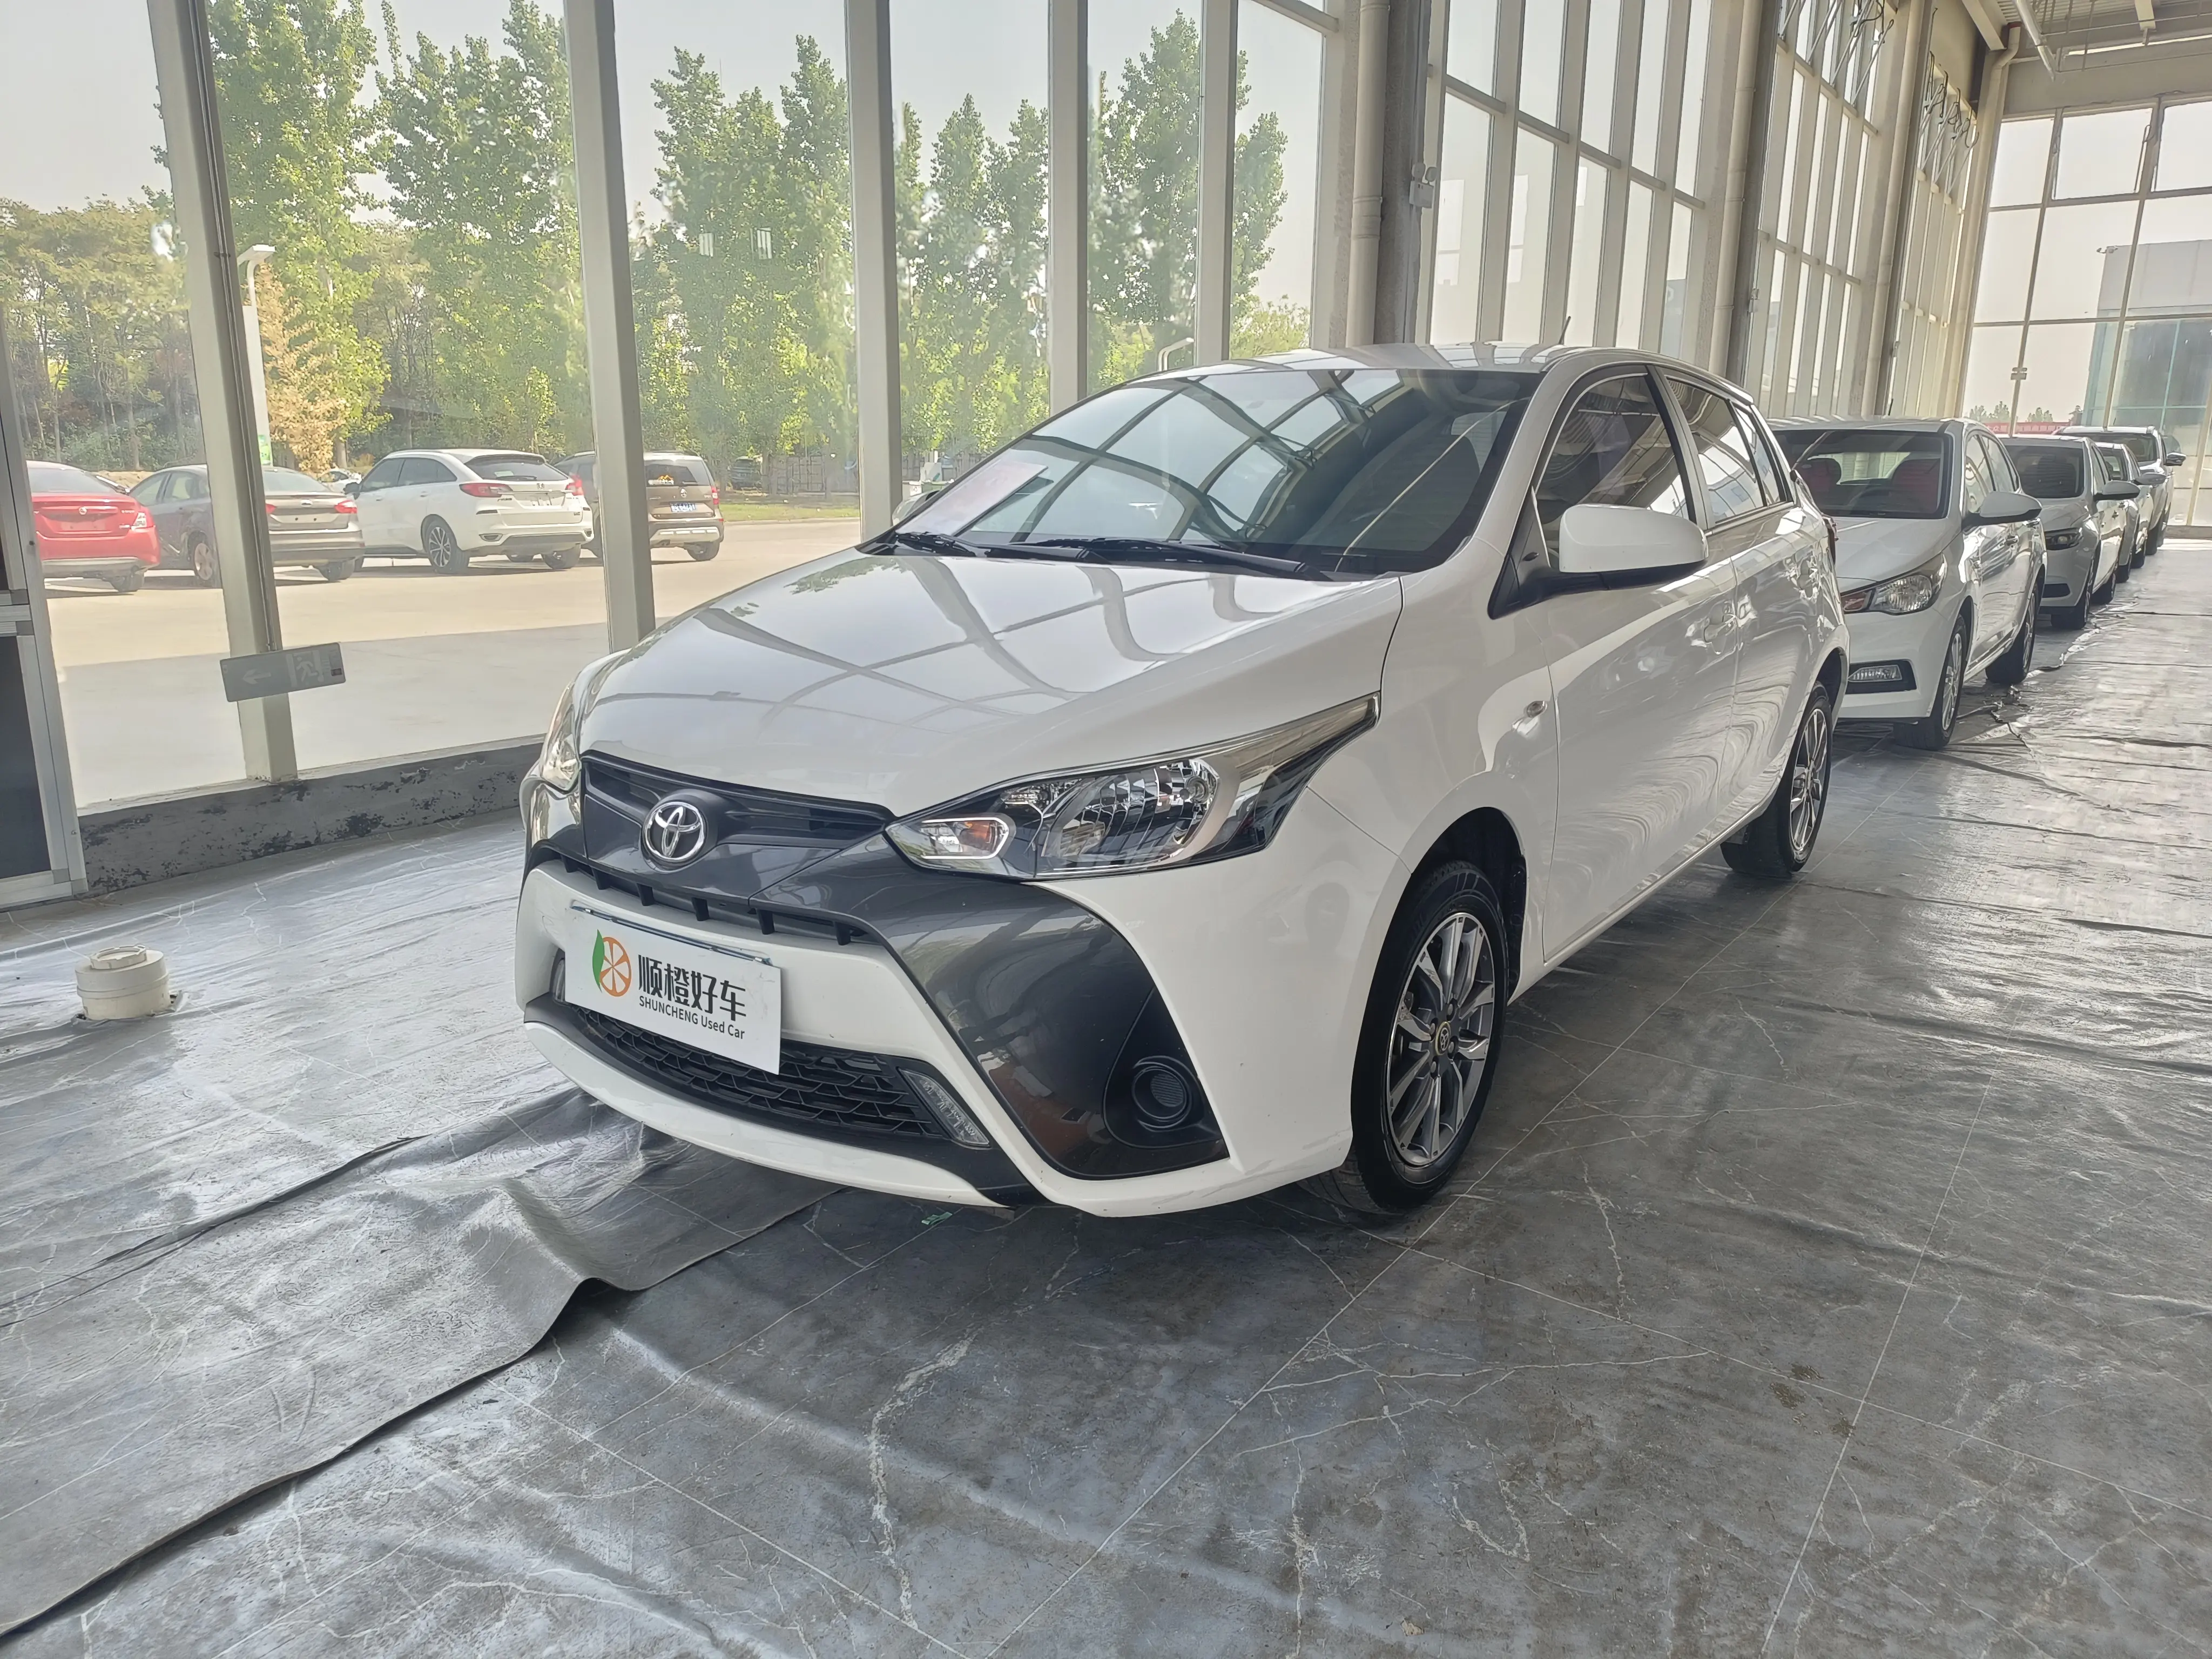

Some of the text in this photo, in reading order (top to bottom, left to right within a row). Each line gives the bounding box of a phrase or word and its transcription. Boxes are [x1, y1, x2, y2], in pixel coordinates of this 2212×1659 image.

[638, 955, 746, 1021] 顺橙好车
[639, 996, 745, 1039] SHUNCHENG Used Car
